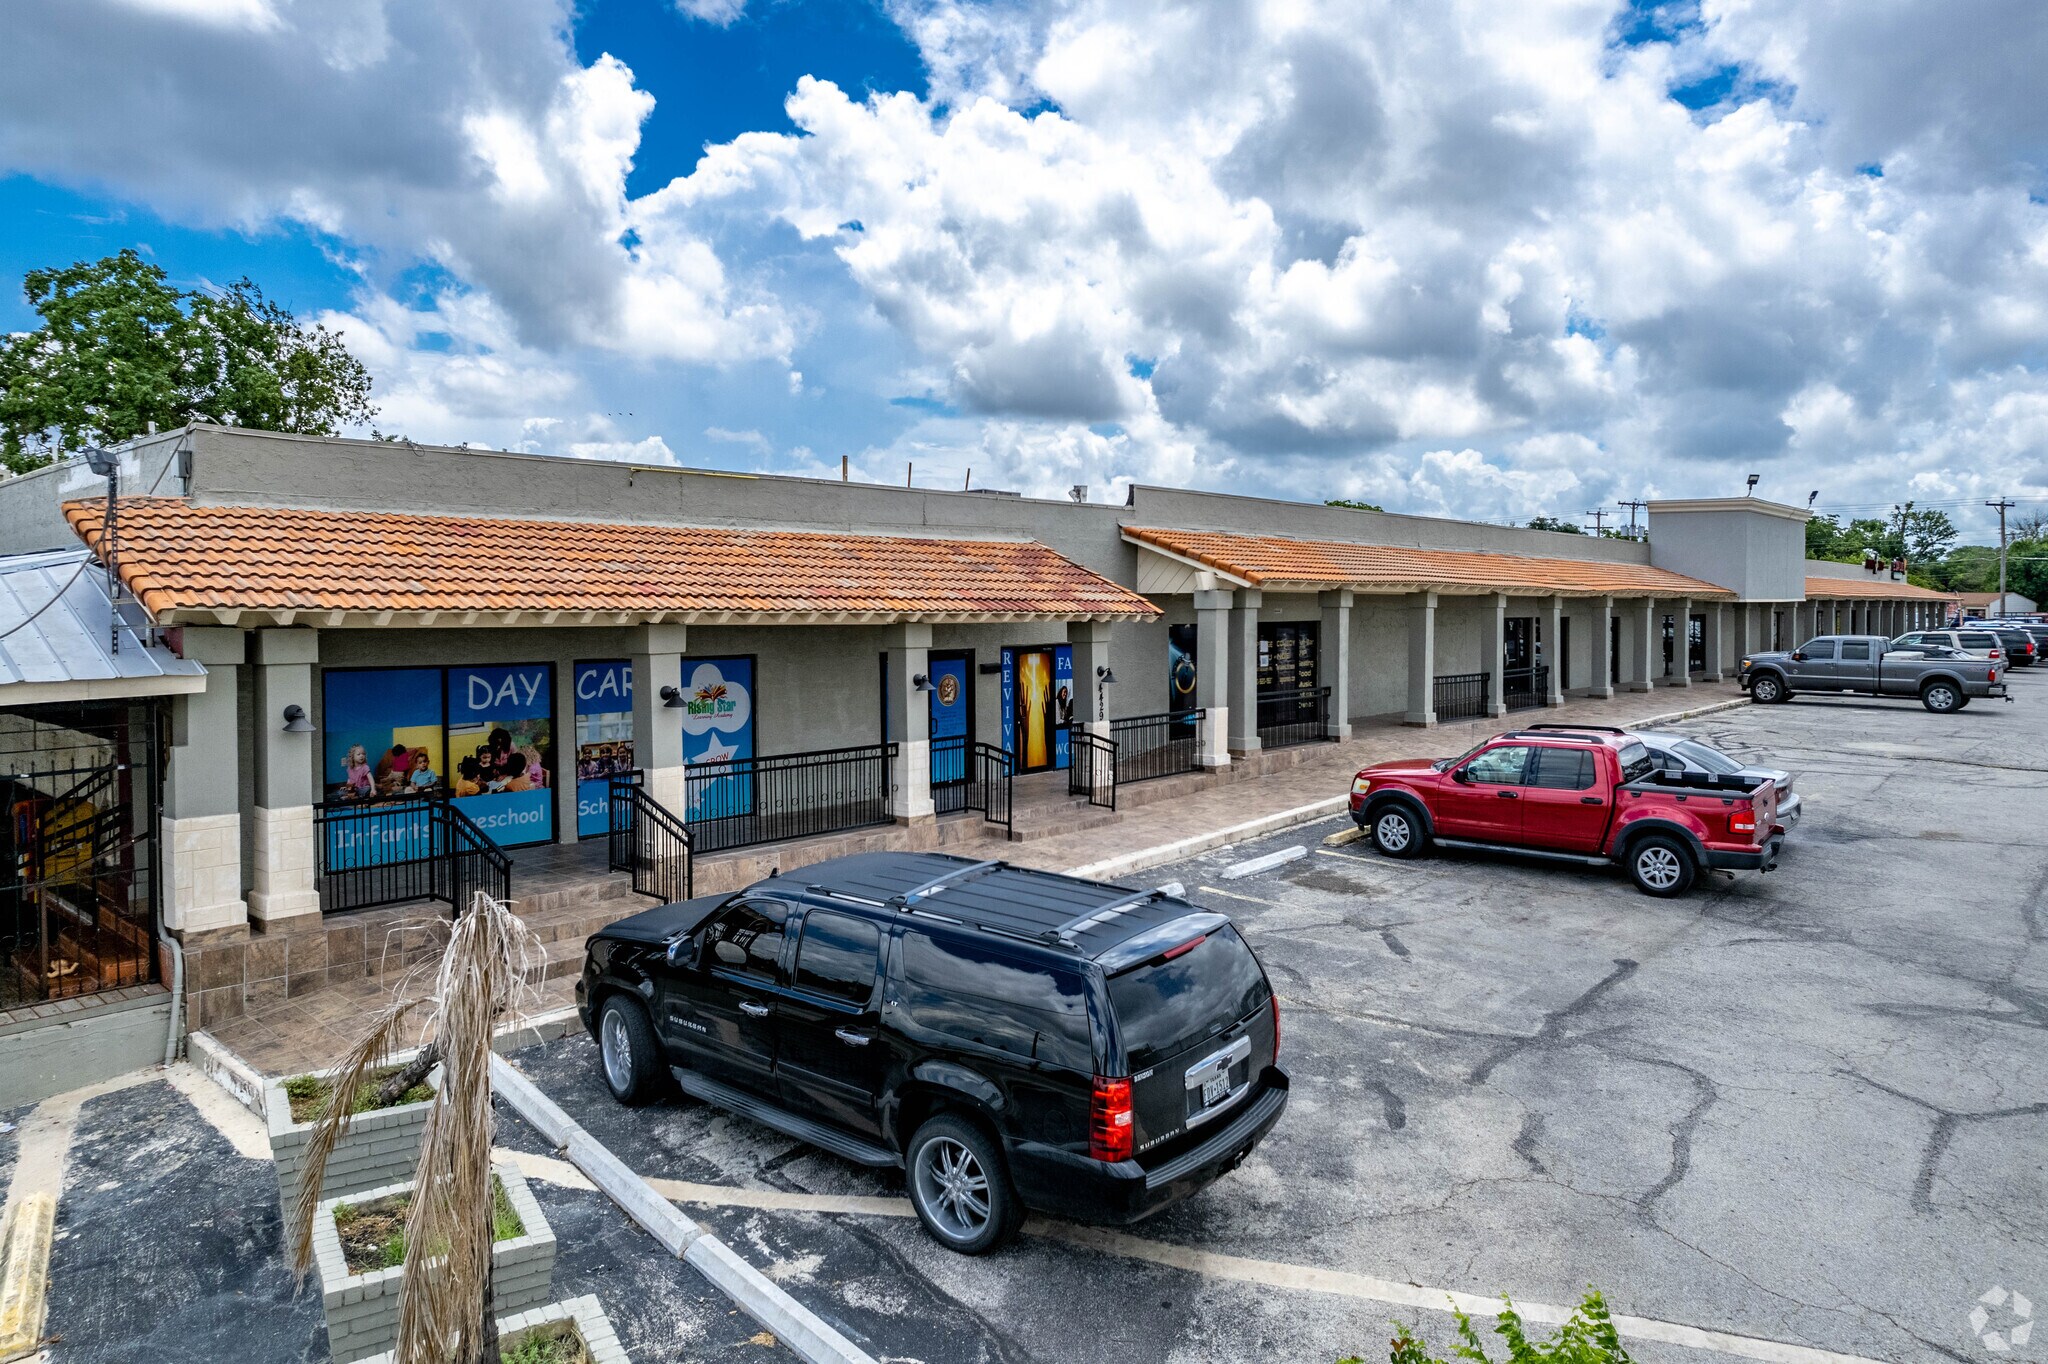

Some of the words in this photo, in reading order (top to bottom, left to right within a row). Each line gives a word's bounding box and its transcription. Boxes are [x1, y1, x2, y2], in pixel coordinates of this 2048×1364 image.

[1057, 657, 1073, 670] FA
[468, 672, 543, 711] DAY
[687, 701, 715, 716] Rising
[717, 699, 736, 713] Star
[334, 823, 430, 849] Infants
[669, 1015, 707, 1033] SUBURBAN
[1139, 1127, 1180, 1151] SUBURBAN
